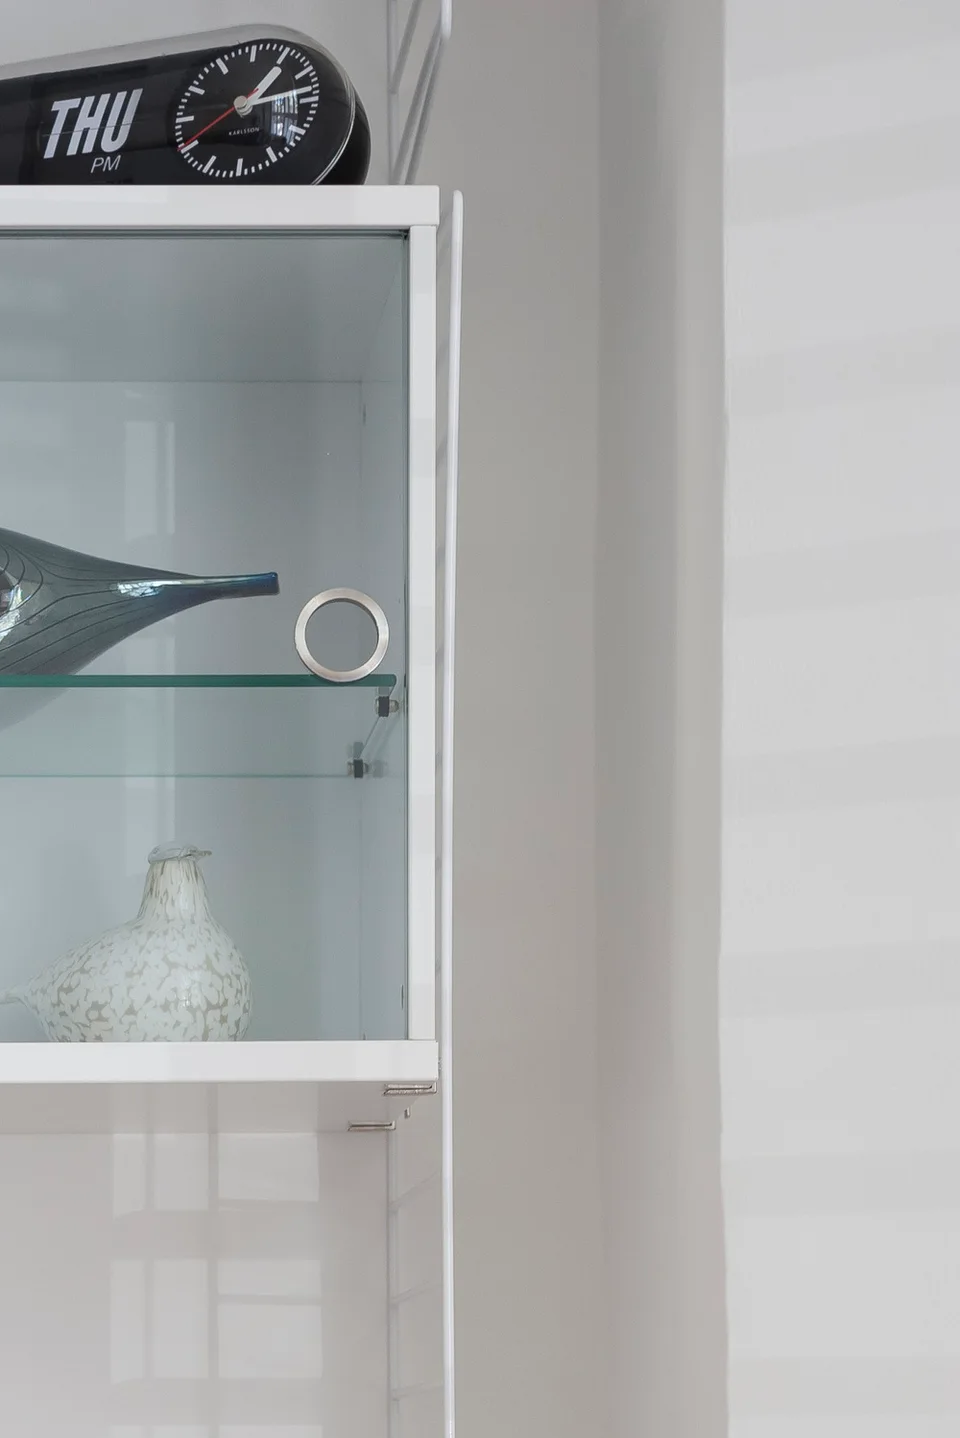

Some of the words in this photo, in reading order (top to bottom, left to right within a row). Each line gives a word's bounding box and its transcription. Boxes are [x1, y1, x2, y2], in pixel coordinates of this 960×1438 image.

[44, 88, 143, 159] THU
[228, 127, 260, 137] KARLSSON
[90, 155, 122, 174] PM
